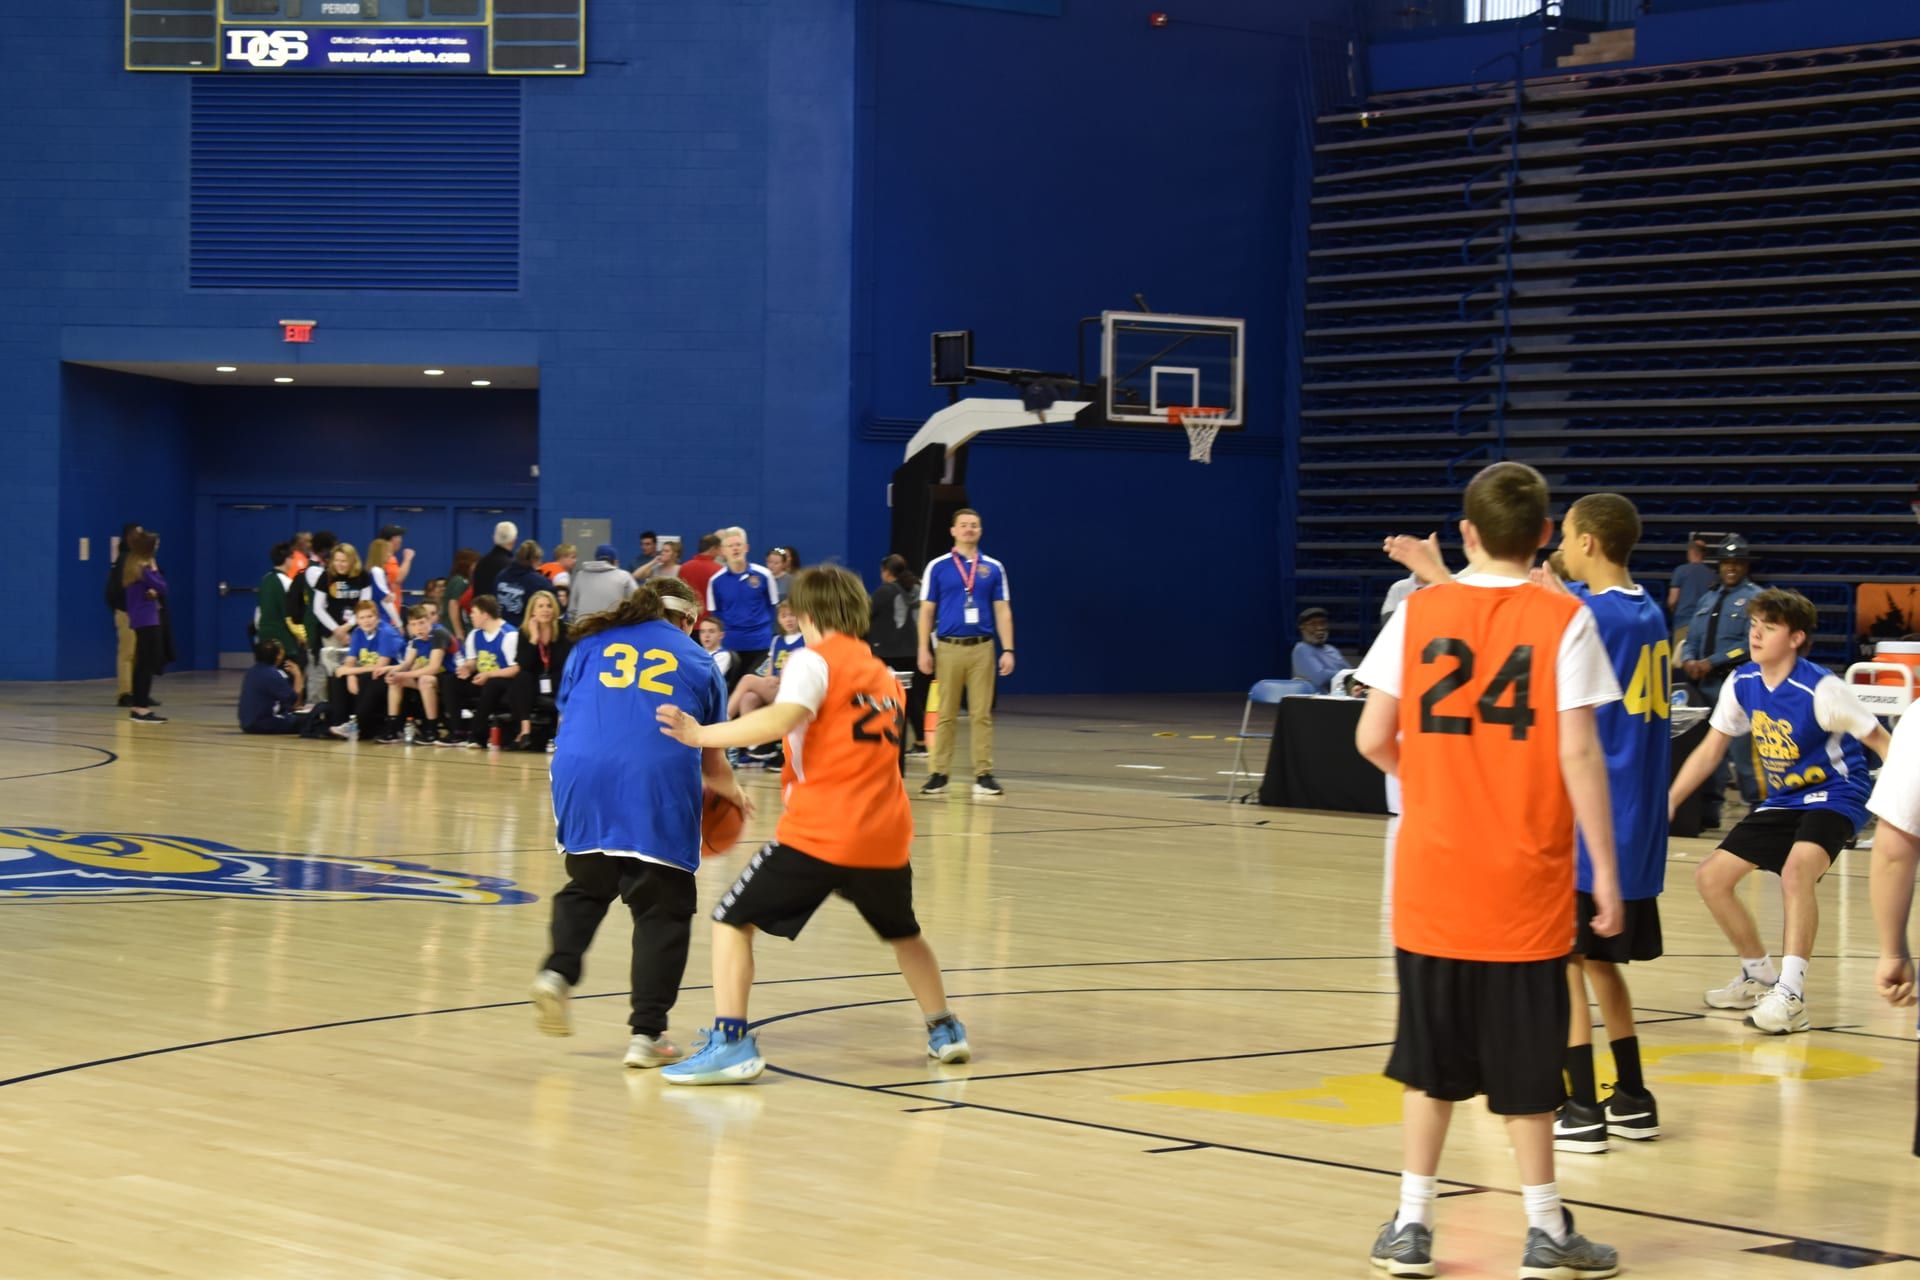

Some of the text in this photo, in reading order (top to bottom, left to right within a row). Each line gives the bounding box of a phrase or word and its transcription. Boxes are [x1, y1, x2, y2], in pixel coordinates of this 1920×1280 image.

[321, 3, 360, 14] PERIOD
[599, 643, 679, 696] 32
[1419, 637, 1537, 741] 24
[1622, 639, 1672, 723] 40
[851, 692, 904, 745] 23
